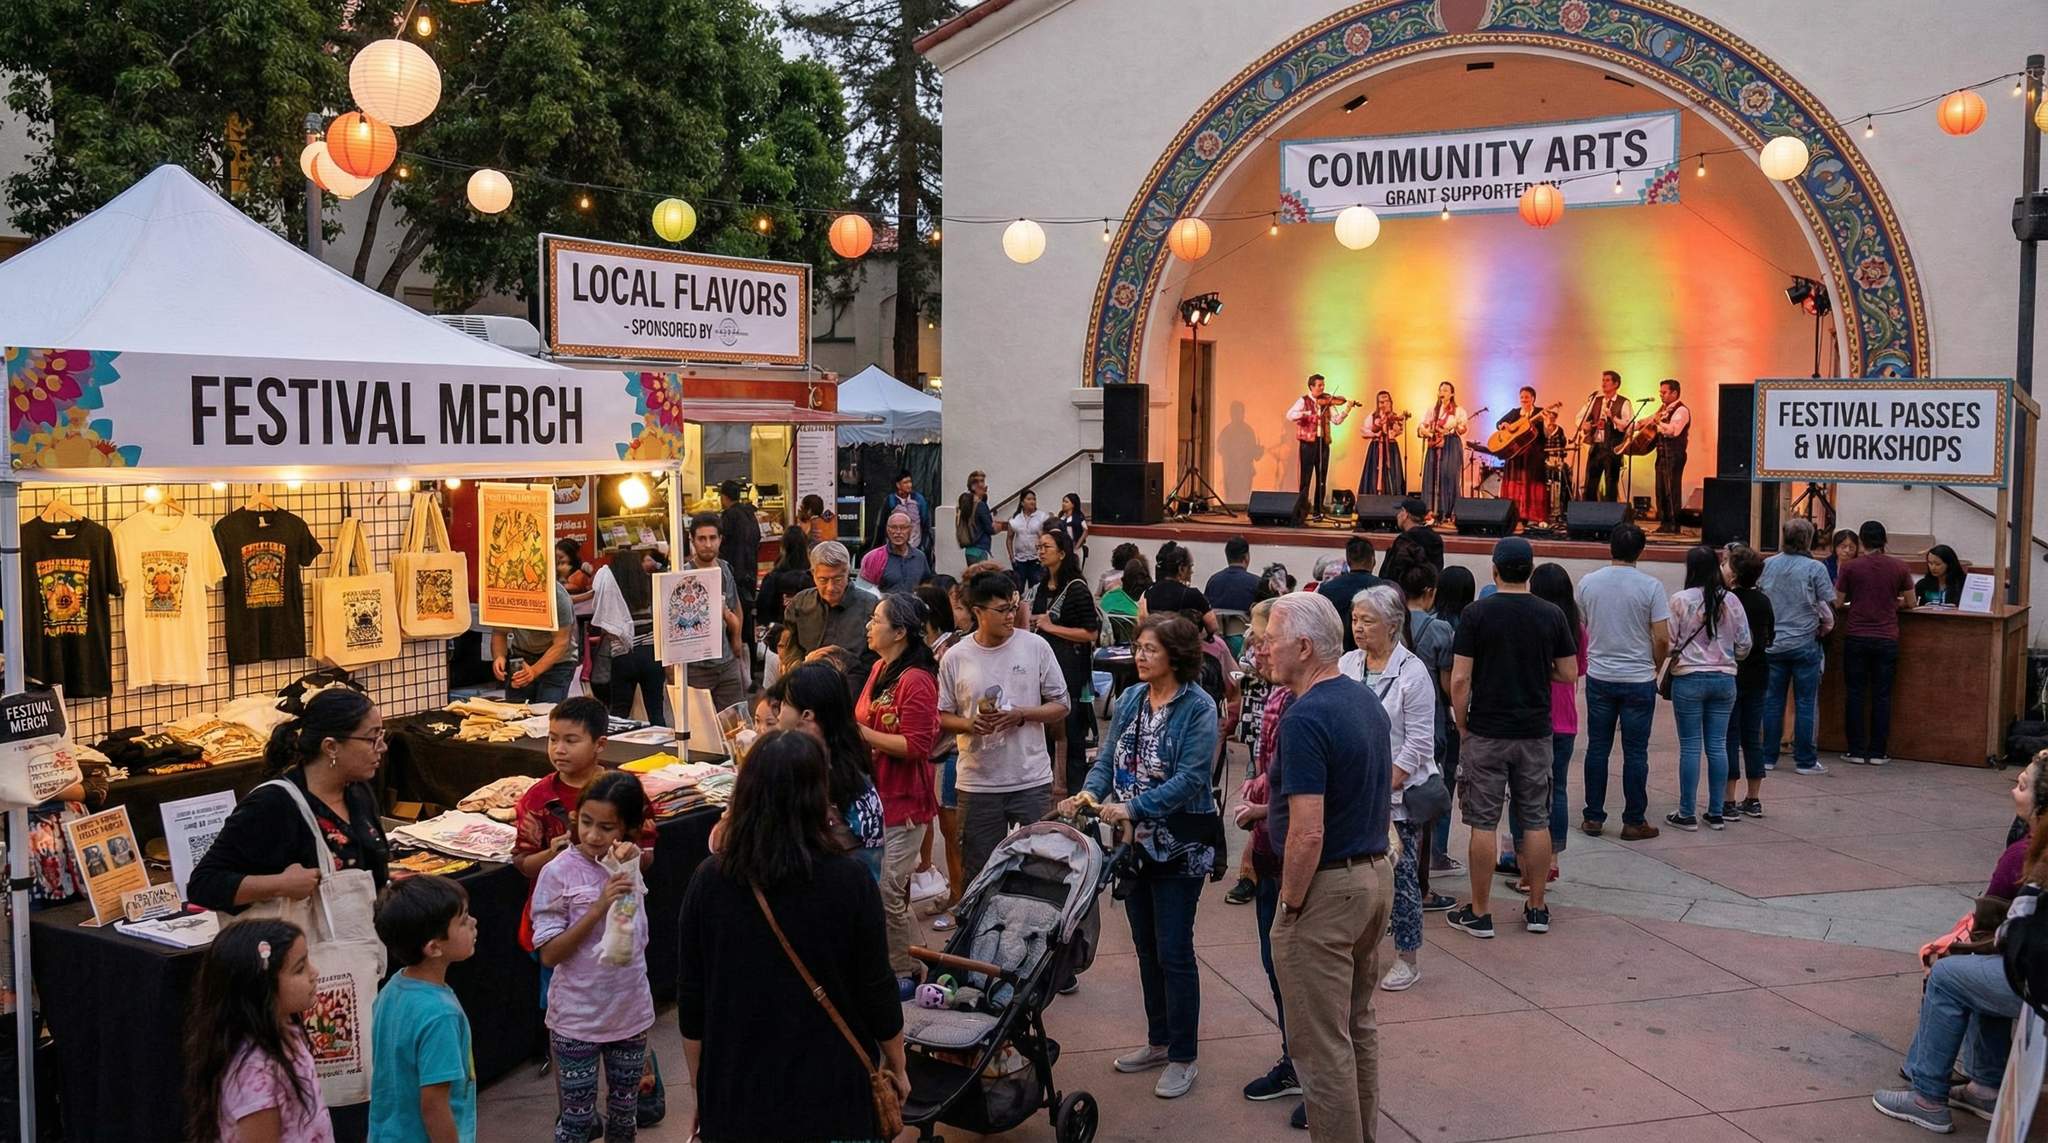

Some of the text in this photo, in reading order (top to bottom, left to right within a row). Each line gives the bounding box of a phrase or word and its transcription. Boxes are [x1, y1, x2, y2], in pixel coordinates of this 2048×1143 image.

[1307, 128, 1648, 189] COMMUNITY ARTS
[1385, 186, 1437, 207] GRANT
[572, 261, 788, 318] LOCAL FLAVORS
[631, 318, 697, 339] SPONSORED
[699, 323, 713, 340] BY
[191, 375, 583, 446] FESTIVAL MERCH
[1778, 401, 1982, 429] FESTIVAL PASSES
[1794, 433, 1962, 462] & WORKSHOPS
[6, 700, 55, 720] FESTIVAL
[10, 714, 49, 734] MERCH
